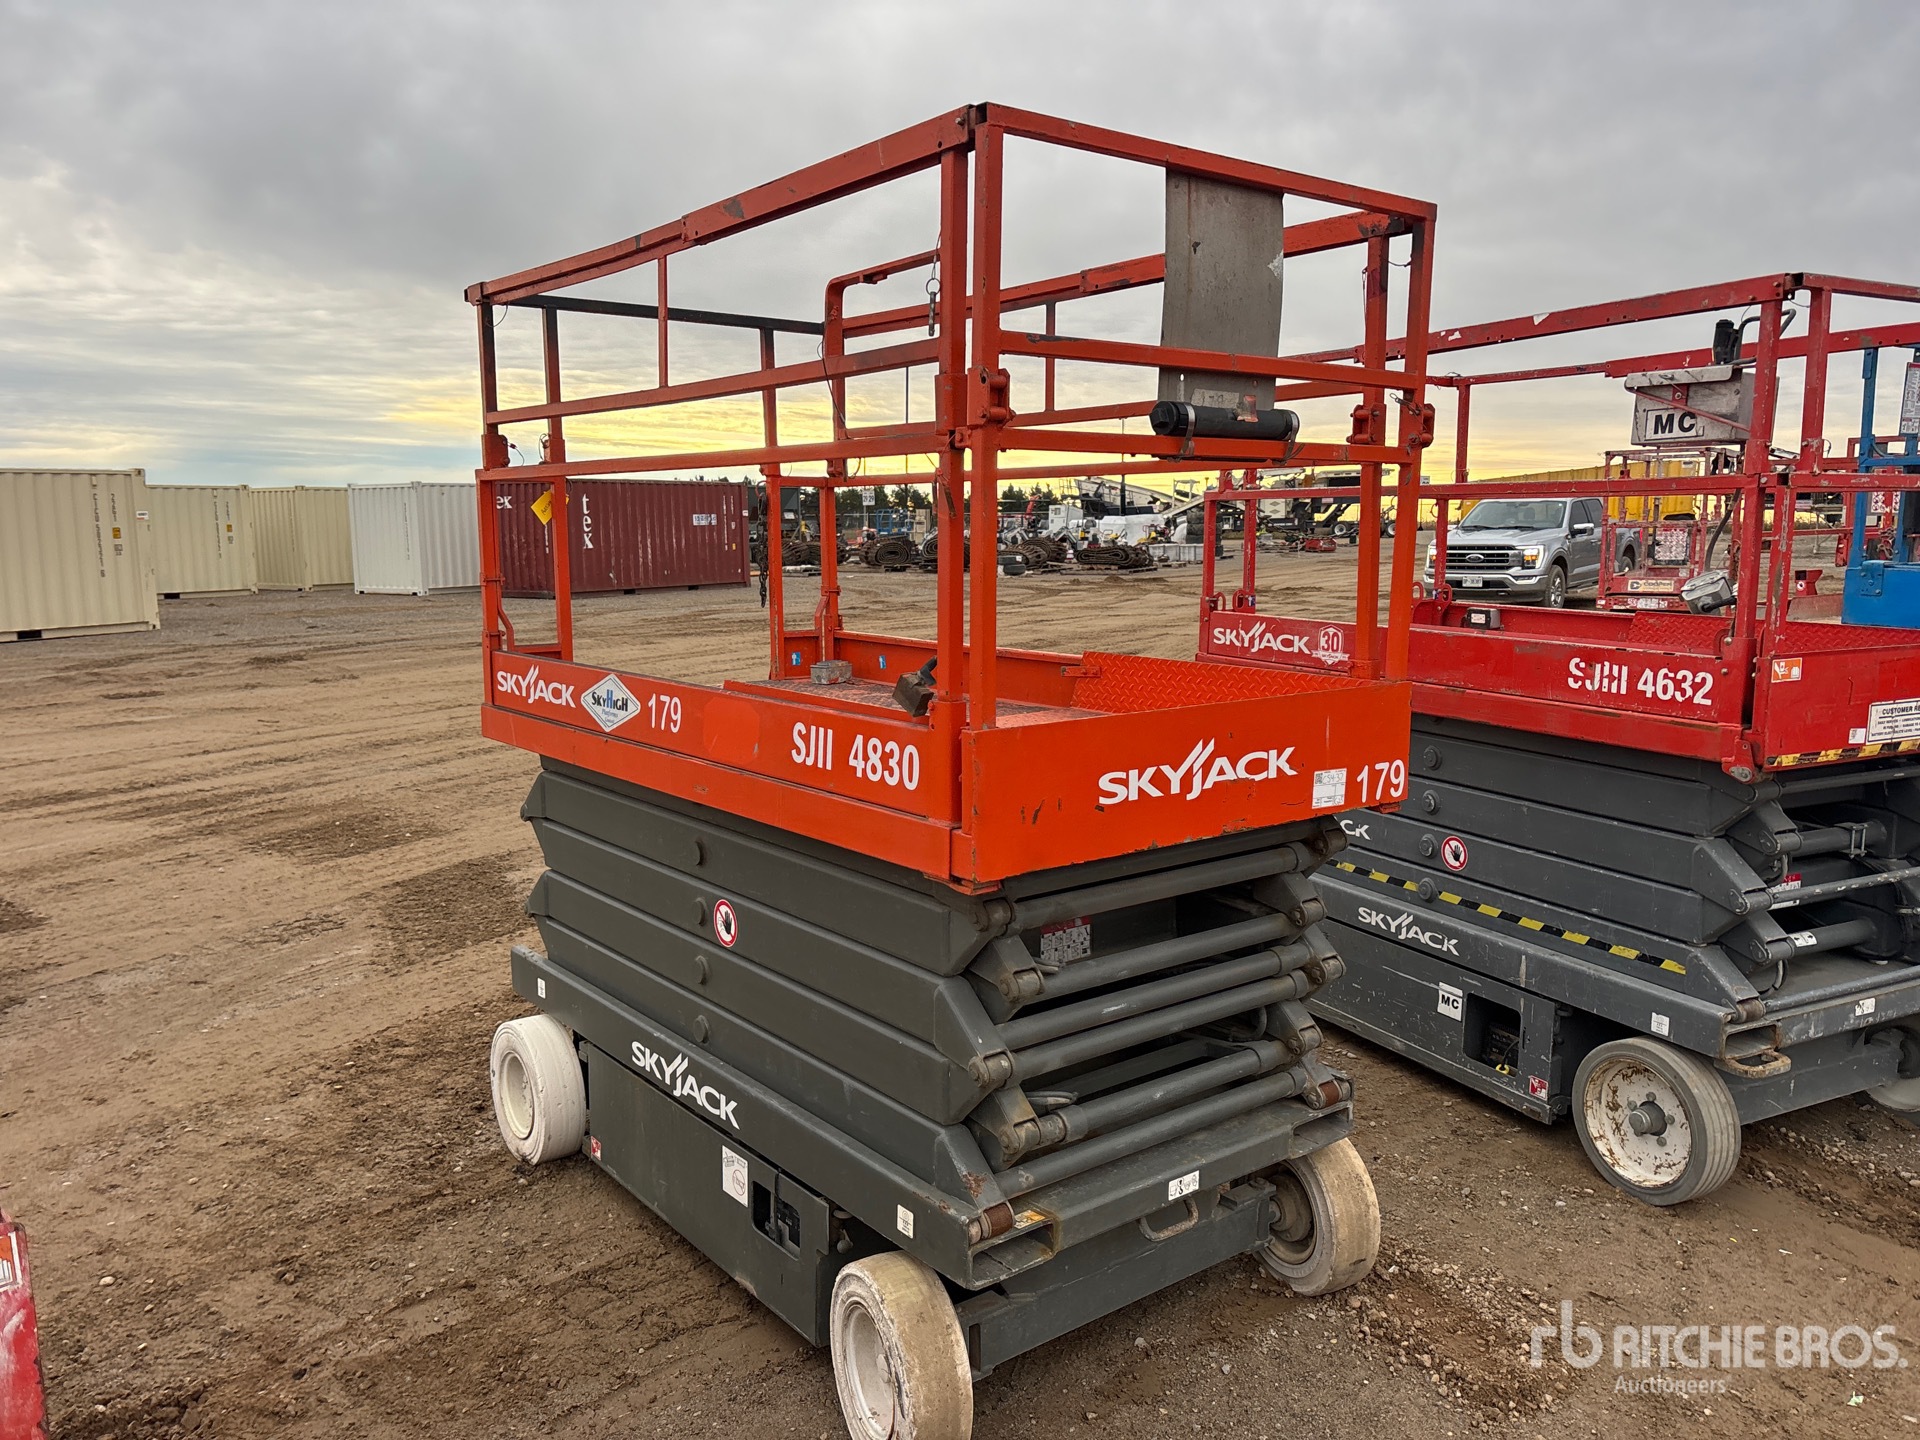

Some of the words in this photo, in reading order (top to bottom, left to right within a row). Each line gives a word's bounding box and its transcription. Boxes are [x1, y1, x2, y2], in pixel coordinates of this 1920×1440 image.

[1653, 411, 1697, 435] MC
[496, 496, 512, 509] ex
[582, 493, 594, 549] tex
[1213, 620, 1311, 655] SKYJACK
[1321, 631, 1341, 653] 30
[496, 664, 576, 708] SKYJACK
[1637, 667, 1714, 706] 4632
[648, 693, 682, 734] 179
[1882, 706, 1913, 716] CUSTOMER
[848, 734, 920, 791] 4830
[1098, 737, 1299, 805] SKYJACK
[1356, 759, 1406, 803] 179
[1338, 818, 1372, 841] CK
[1358, 907, 1460, 956] SKYJACK
[1441, 994, 1460, 1010] MC
[631, 1041, 740, 1130] SKYJACK
